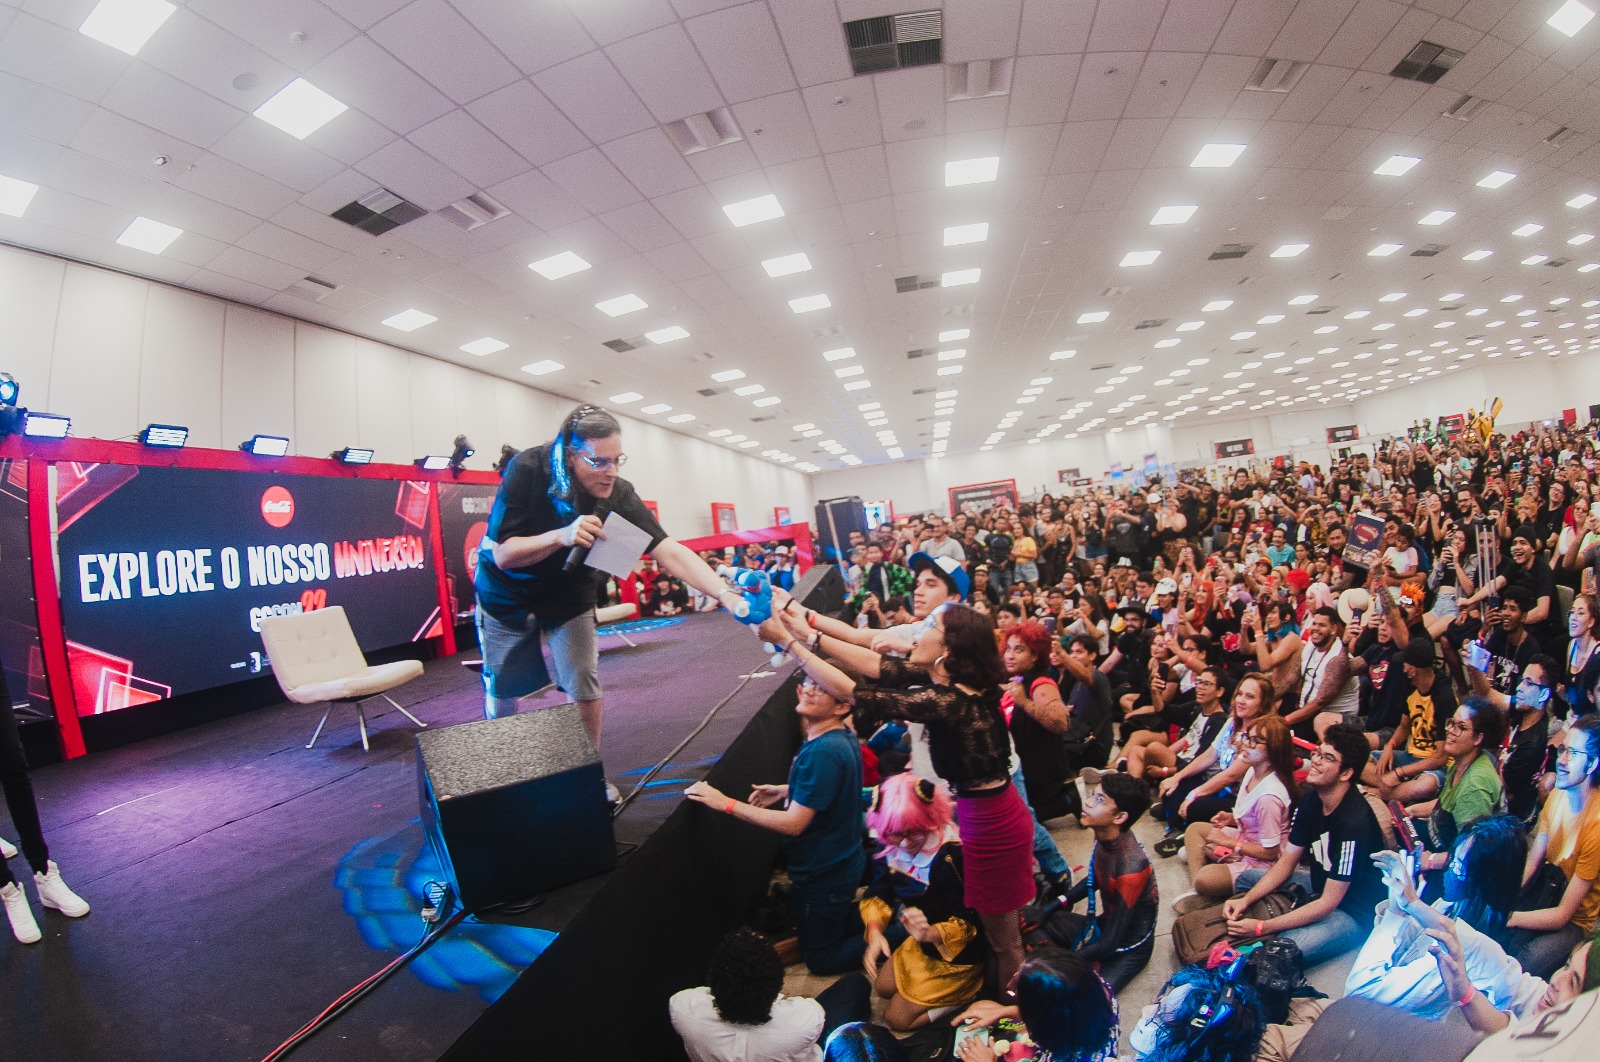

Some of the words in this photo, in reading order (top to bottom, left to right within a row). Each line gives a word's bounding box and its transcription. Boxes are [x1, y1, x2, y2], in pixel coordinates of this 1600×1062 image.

[79, 548, 215, 602] EXPLORE
[220, 546, 241, 589] O
[247, 542, 331, 586] NOSSO
